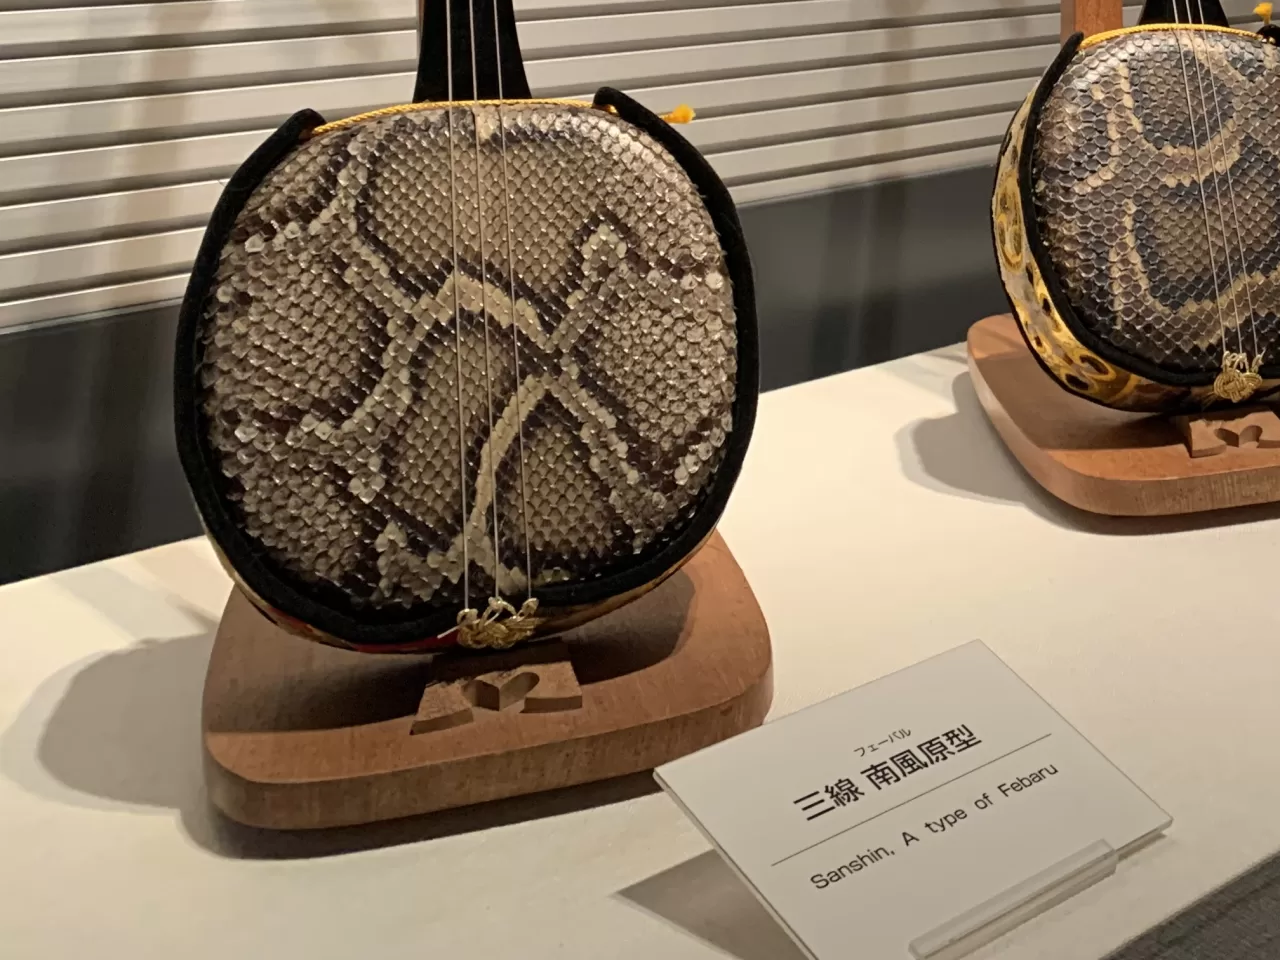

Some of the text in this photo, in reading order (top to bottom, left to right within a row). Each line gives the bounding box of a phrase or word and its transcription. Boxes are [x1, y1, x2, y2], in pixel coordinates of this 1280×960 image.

[793, 724, 982, 821] 三線 南風原型
[854, 728, 911, 757] フェーバル
[810, 764, 1059, 889] Sanshin, A type of Febaru
